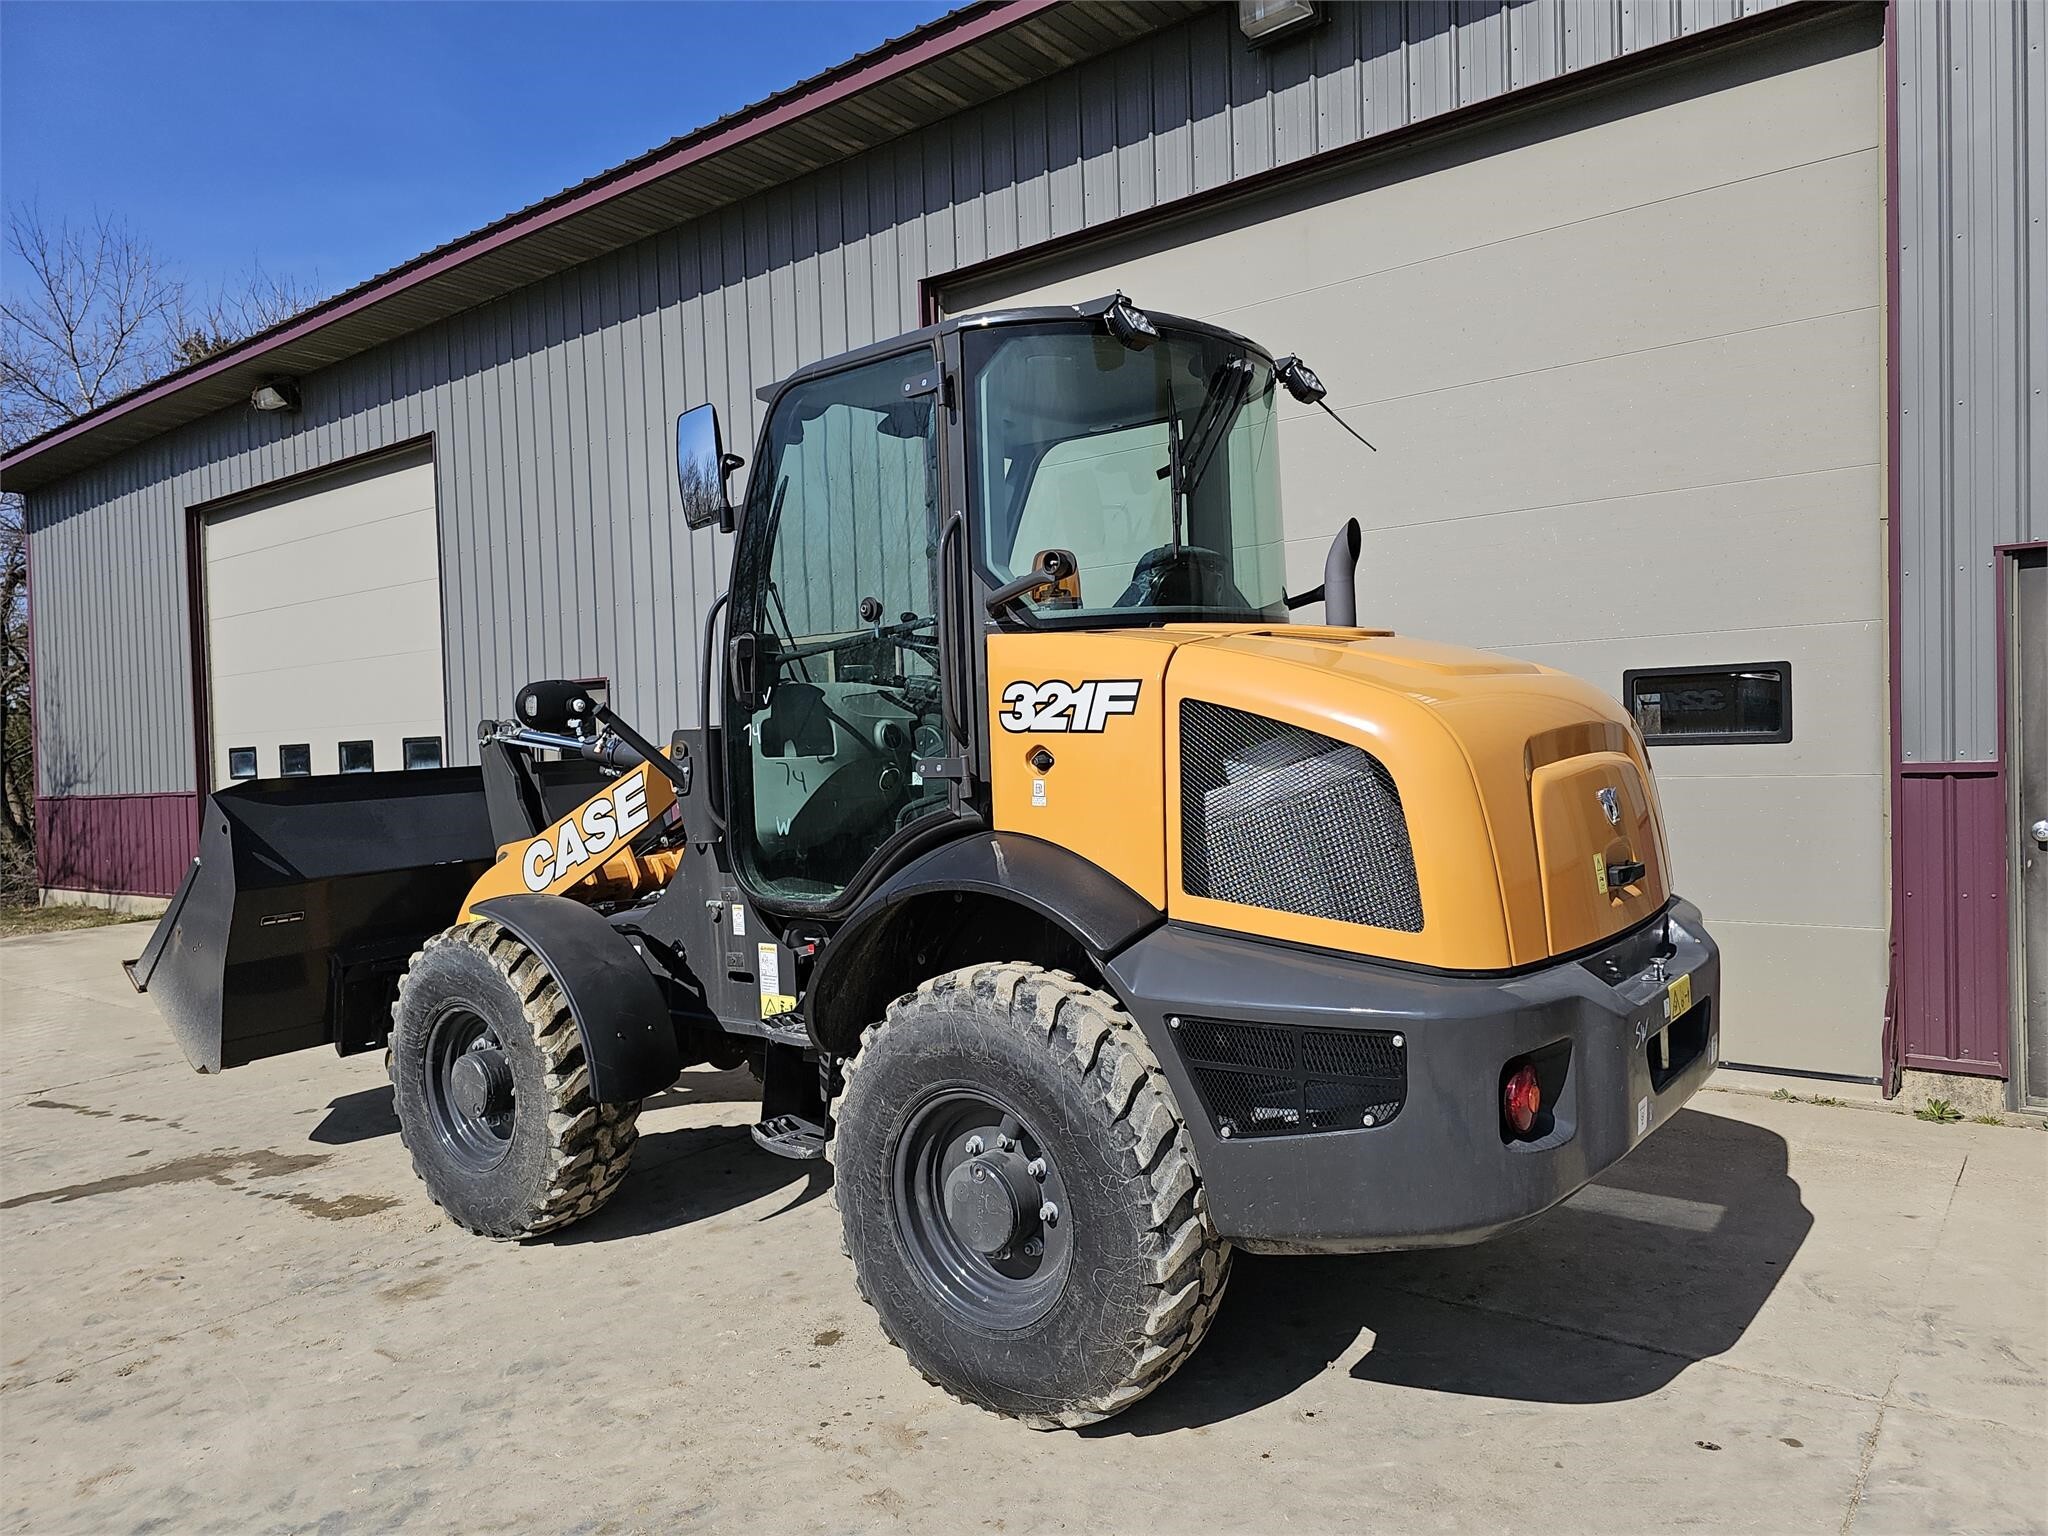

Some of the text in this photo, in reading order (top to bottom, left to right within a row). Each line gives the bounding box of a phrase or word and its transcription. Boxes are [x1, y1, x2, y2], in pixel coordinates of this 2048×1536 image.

[999, 679, 1143, 733] 321F
[743, 723, 761, 746] 74
[522, 770, 650, 892] CASE
[776, 816, 791, 836] W
